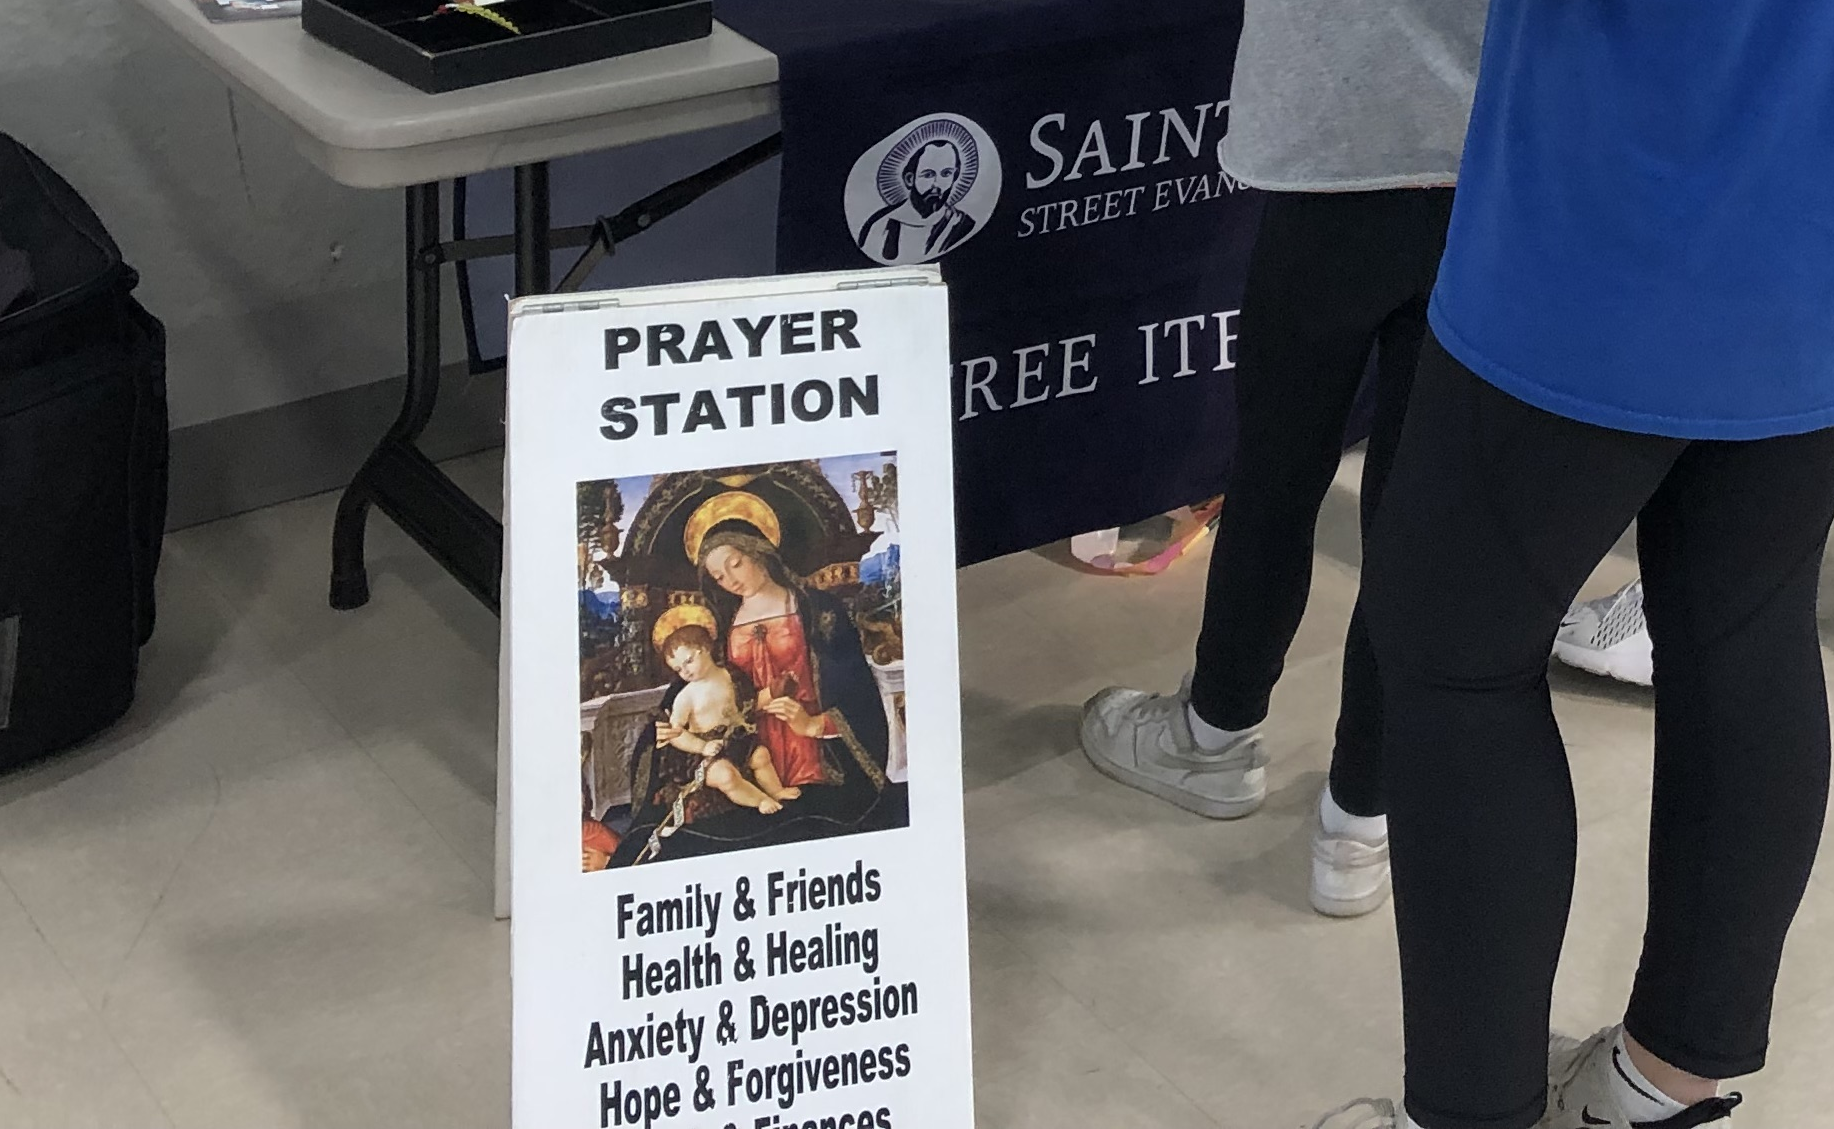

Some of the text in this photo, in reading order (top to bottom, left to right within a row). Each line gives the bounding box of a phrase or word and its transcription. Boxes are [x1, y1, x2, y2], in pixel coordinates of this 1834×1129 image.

[1017, 186, 1146, 238] STREET
[604, 308, 861, 370] PRAYER
[949, 334, 1098, 422] REE
[599, 374, 879, 441] STATION
[616, 859, 882, 940] Family & Friends
[621, 922, 879, 1000] Health & Healing
[583, 976, 918, 1069] Anxiety & Depression
[600, 1079, 681, 1129] Hope
[693, 1065, 716, 1112] &
[726, 1041, 912, 1109] Forgiveness
